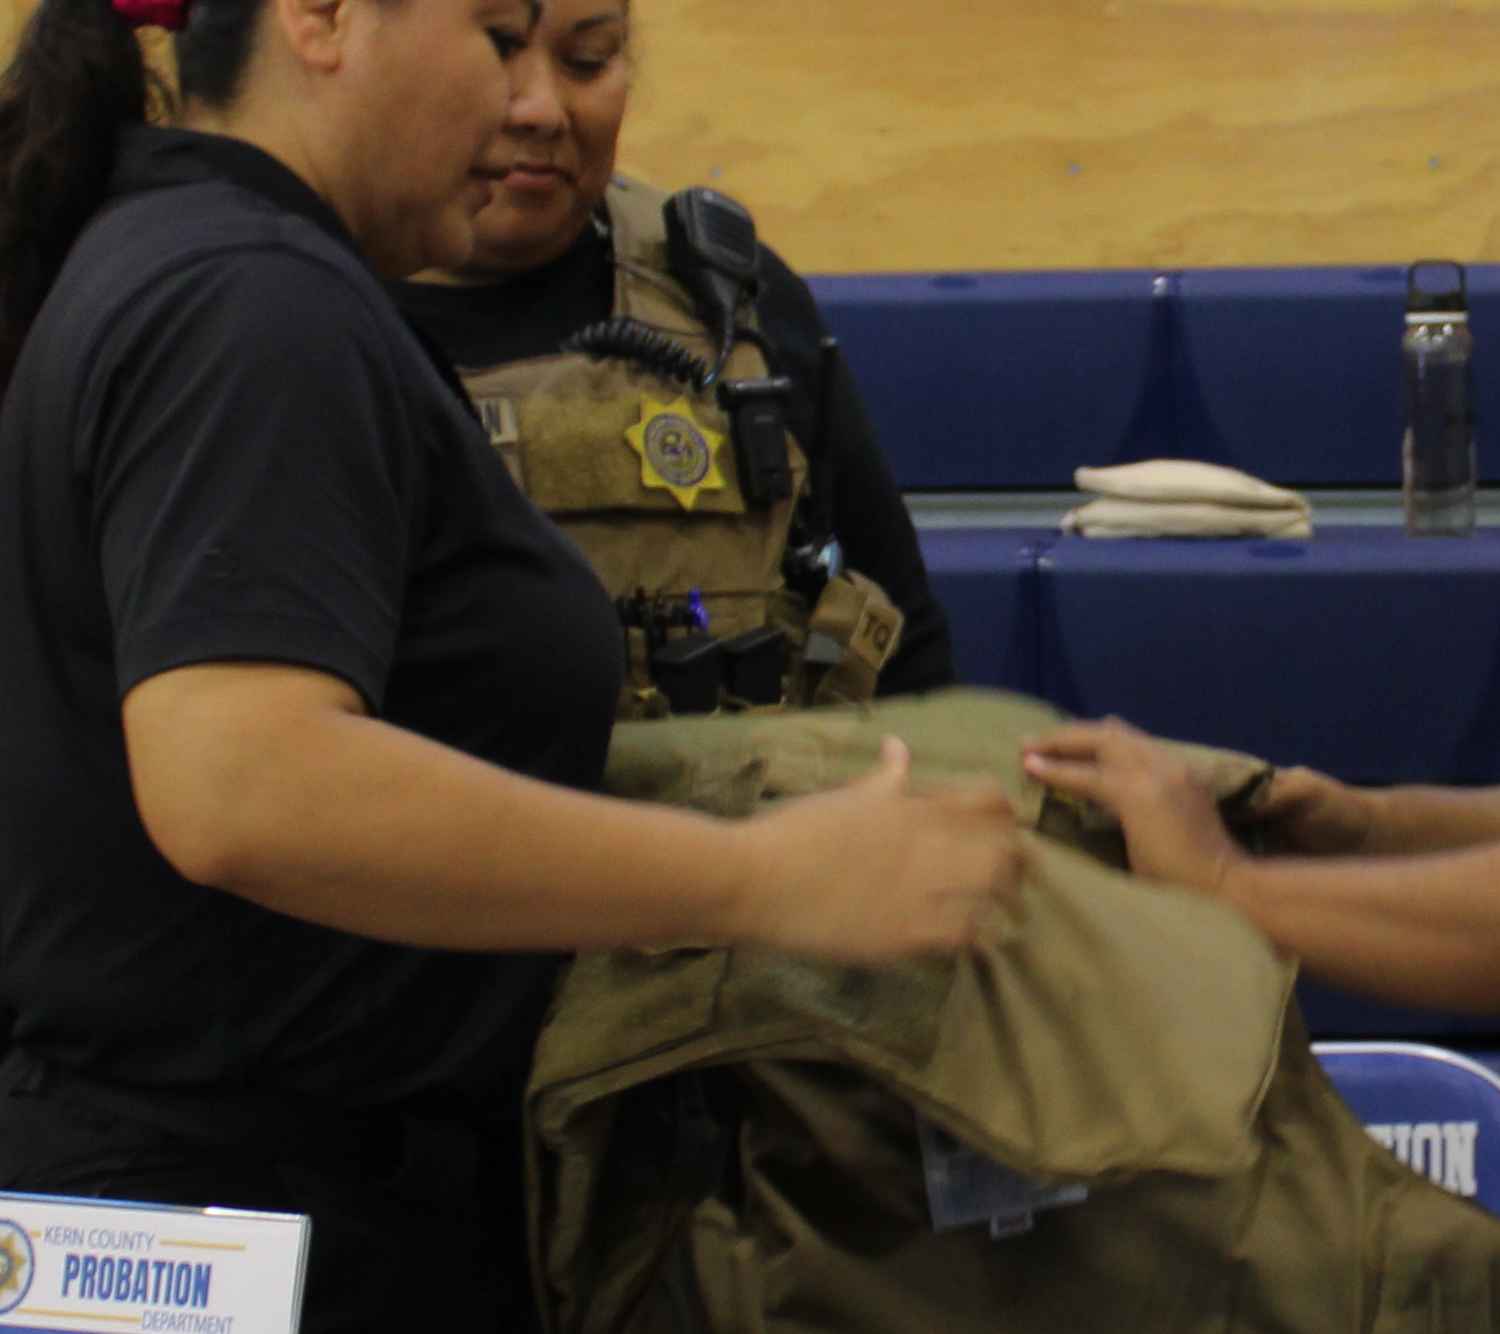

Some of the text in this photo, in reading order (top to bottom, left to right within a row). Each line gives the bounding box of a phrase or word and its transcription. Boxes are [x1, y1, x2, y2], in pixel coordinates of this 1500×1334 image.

[860, 610, 893, 650] TQ
[44, 1225, 155, 1252] KERN COUNTY
[61, 1253, 212, 1308] PROBATION
